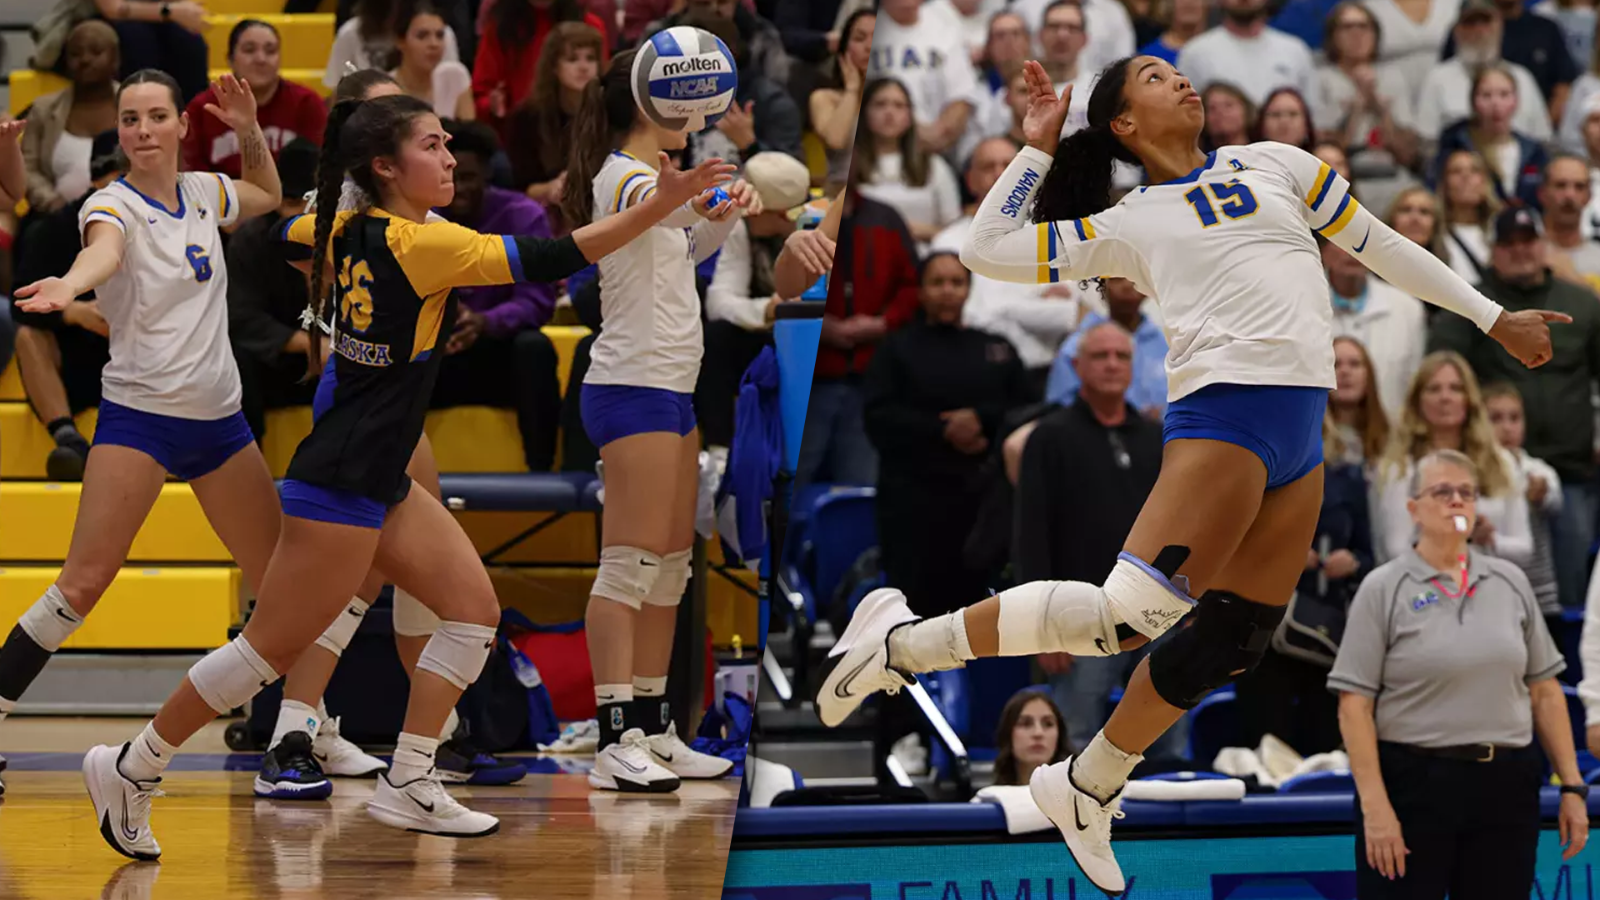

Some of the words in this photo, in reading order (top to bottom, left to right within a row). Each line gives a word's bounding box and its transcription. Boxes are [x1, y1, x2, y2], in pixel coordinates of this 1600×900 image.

[662, 58, 721, 76] molten
[670, 77, 718, 97] NCAA
[1000, 167, 1040, 218] NANOOKS
[1183, 179, 1260, 229] 15
[185, 244, 214, 285] 6
[334, 328, 393, 367] LASKA
